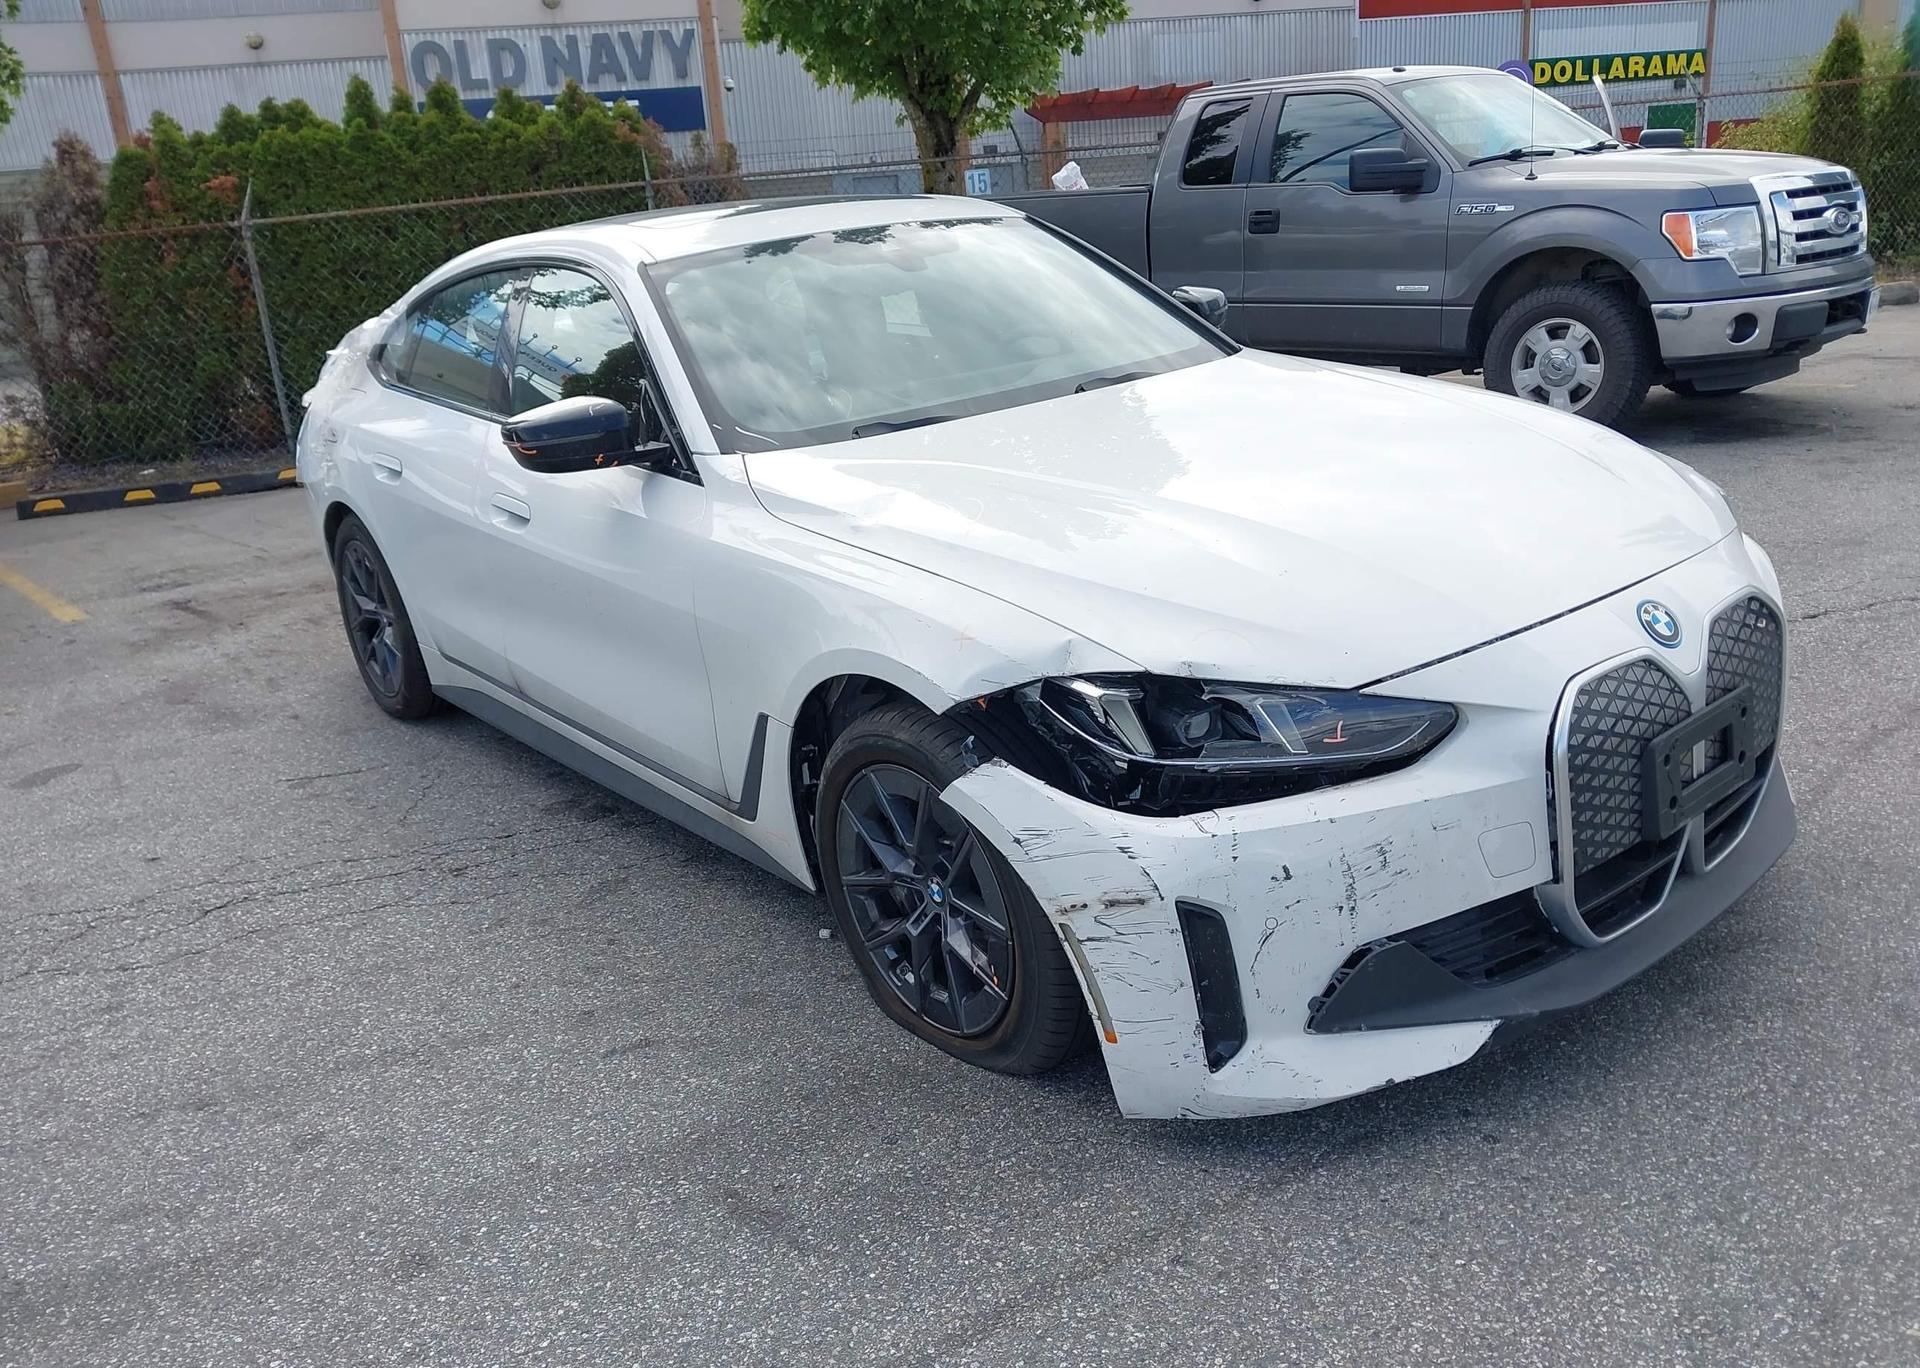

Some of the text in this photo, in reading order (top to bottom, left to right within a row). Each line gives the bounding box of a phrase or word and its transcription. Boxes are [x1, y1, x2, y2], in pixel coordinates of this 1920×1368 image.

[410, 28, 696, 92] OLD NAVY
[1534, 52, 1706, 84] DOLLARAMA
[968, 172, 988, 194] 15
